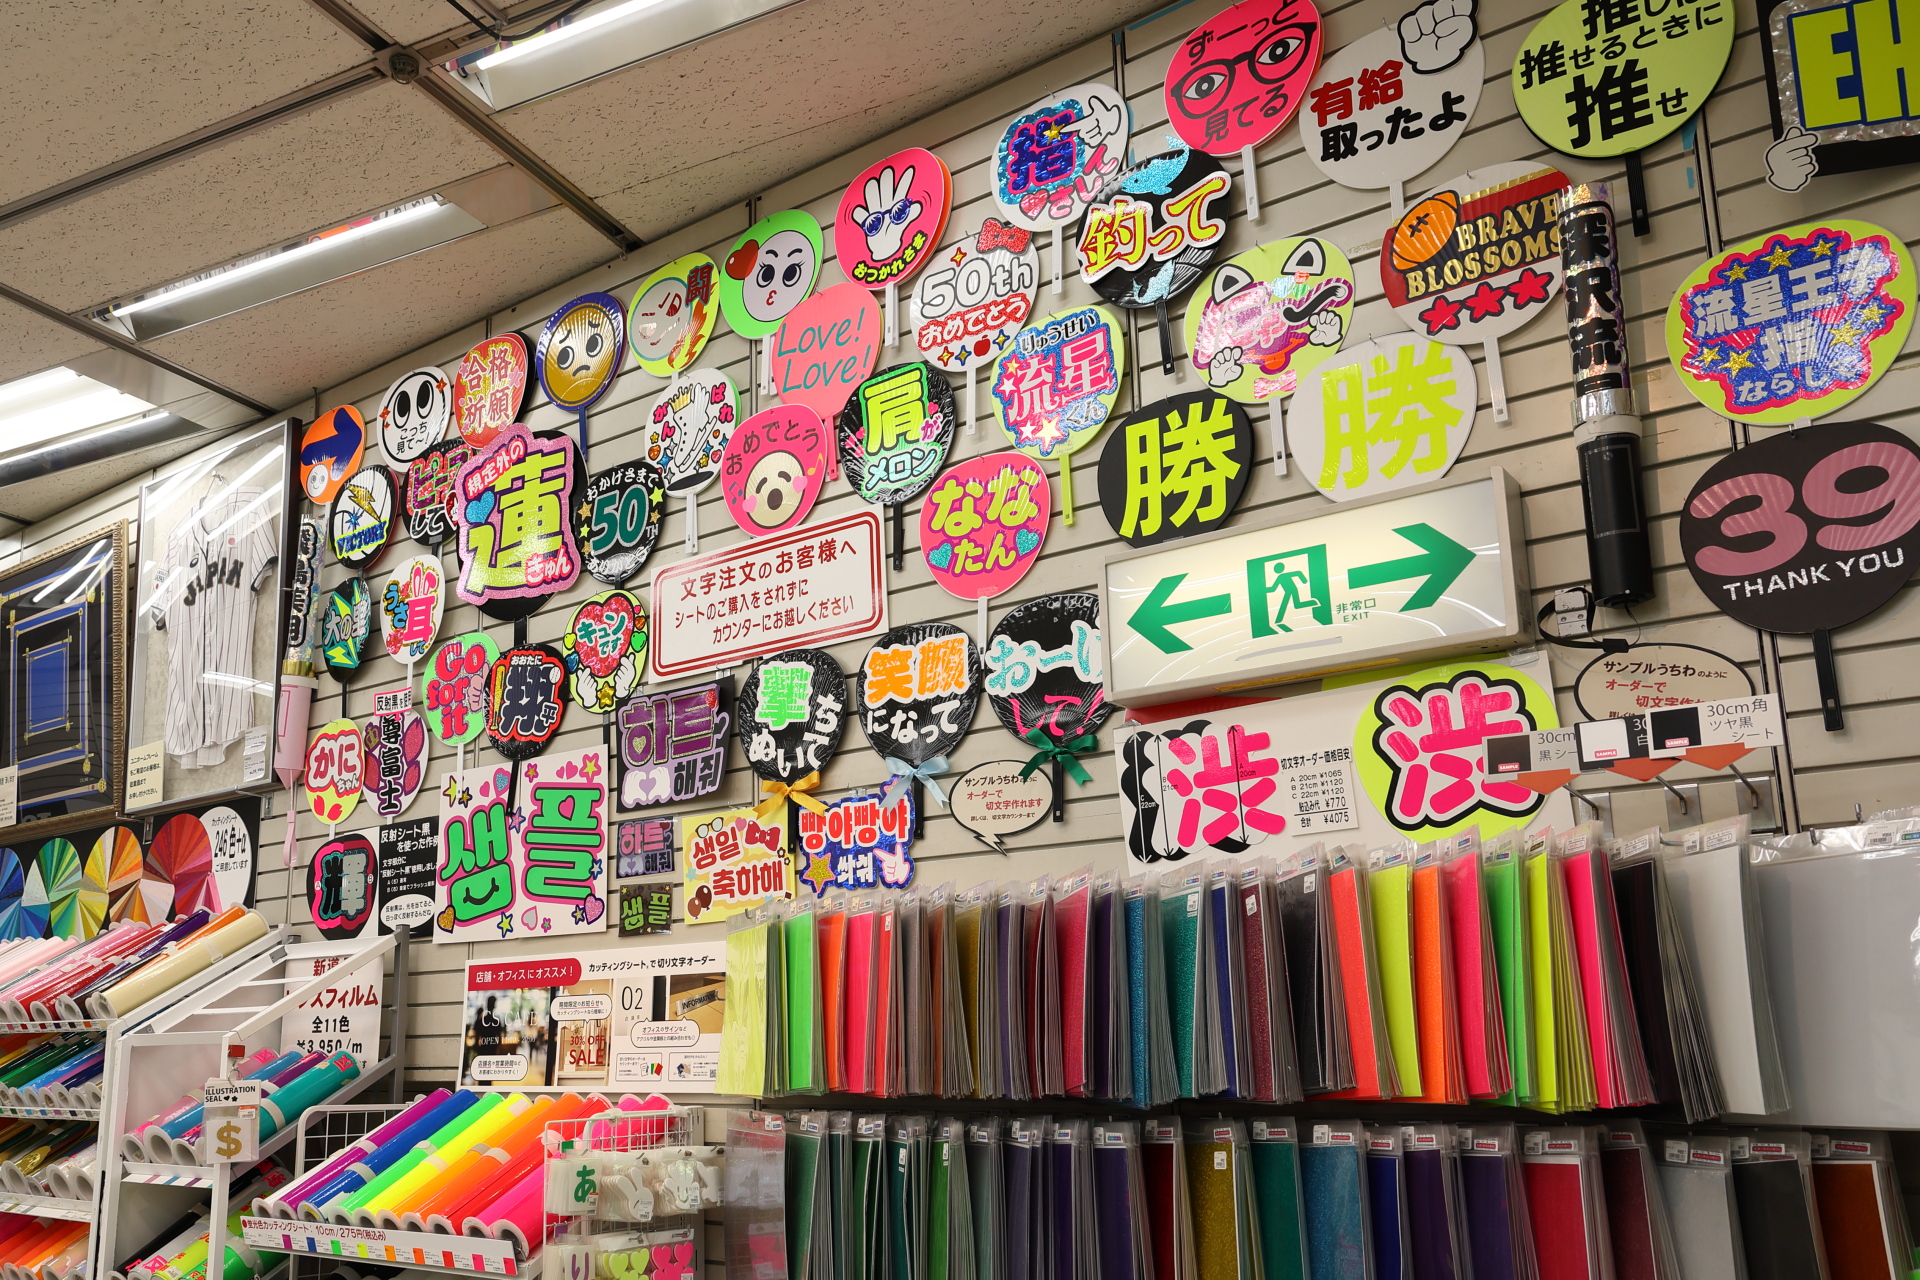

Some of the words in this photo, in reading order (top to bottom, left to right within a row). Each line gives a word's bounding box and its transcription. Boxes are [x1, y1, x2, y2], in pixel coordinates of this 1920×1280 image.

[1580, 0, 1699, 40] 推し
[1519, 2, 1724, 90] 推せるときに
[1309, 60, 1405, 127] 有給
[1564, 58, 1690, 150] 推せ
[1202, 84, 1289, 149] 見てる
[1319, 90, 1468, 163] 取ったよ
[1008, 109, 1077, 195] 指
[1082, 172, 1227, 282] 釣って
[1456, 196, 1562, 251] BRAVE
[854, 232, 928, 283] おつかれさま
[1406, 227, 1565, 300] BLOSSOMS
[685, 265, 715, 307] 闘
[920, 255, 1034, 319] 50th
[1695, 244, 1892, 336] 流星王子
[778, 307, 866, 360] Love!
[918, 294, 1032, 349] おめでとう
[1020, 310, 1098, 353] りゅうせい
[463, 346, 513, 392] 合格
[781, 343, 871, 394] Love!
[1008, 328, 1112, 423] 流星
[463, 389, 512, 430] 祈願
[653, 402, 676, 440] がん
[710, 382, 734, 423] ばれ
[863, 370, 926, 455] 肩
[1064, 398, 1104, 427] くん
[1317, 340, 1465, 492] 勝
[399, 420, 428, 442] こっち
[726, 419, 820, 476] おめでとう
[465, 440, 527, 498] 規定外の
[586, 465, 660, 502] おかげさまで
[867, 447, 939, 488] メロン
[1118, 398, 1242, 540] 勝
[590, 483, 650, 557] 50
[930, 464, 1041, 538] なな
[1689, 441, 1920, 577] 39
[335, 521, 389, 558] VICTORY
[464, 449, 567, 594] 蓮
[646, 523, 660, 539] TH
[525, 546, 573, 584] きゅん
[680, 537, 857, 602] 文字注文のお客様へ
[953, 533, 1017, 574] たん
[1723, 563, 1831, 600] THANK
[1835, 547, 1905, 578] YOU
[385, 583, 410, 629] うさ
[674, 578, 810, 630] シートのご購入をされずに
[711, 595, 855, 646] カウンターにお越しください
[1336, 598, 1377, 614] 非常口
[1343, 611, 1371, 623] EXIT
[576, 610, 628, 643] キュン
[410, 640, 427, 657] して
[434, 642, 486, 681] Go
[510, 655, 543, 666] おおたに
[596, 635, 623, 659] です
[867, 636, 968, 704] 笑顔
[1603, 661, 1729, 682] サンプルうちわのように
[1605, 678, 1668, 694] オーダーで
[427, 677, 470, 711] for
[1706, 697, 1769, 719] 30cm角
[441, 702, 470, 740] it
[541, 701, 560, 727] 平
[623, 697, 718, 767] 하트
[866, 700, 962, 745] になって
[1708, 715, 1755, 732] ツヤ黒
[1594, 749, 1618, 759] SAMPLE
[1666, 737, 1689, 748] SAMPLE
[1731, 728, 1775, 744] シート
[313, 741, 358, 780] かに
[672, 748, 721, 798] 해줘
[1239, 770, 1257, 778] 20cm
[1280, 747, 1351, 771] 切文字オーダー価格目安
[1299, 774, 1318, 782] 20cm
[1319, 770, 1343, 778] ¥1065
[1498, 763, 1520, 772] SAMPLE
[336, 772, 361, 794] ちゃん
[966, 789, 1004, 801] オーダーで
[1162, 784, 1179, 792] 21cm
[1167, 724, 1288, 847] 渋
[1300, 790, 1320, 799] 22cm
[1321, 787, 1345, 795] ¥1120
[1320, 778, 1344, 787] ¥1120
[985, 798, 1044, 811] 切文字作れます
[1140, 801, 1157, 809] 22cm
[1300, 816, 1312, 828] 合計
[1323, 811, 1350, 825] ¥4075
[1324, 796, 1347, 809] ¥770
[380, 822, 431, 845] 反射シート黒
[691, 824, 740, 870] 생일
[437, 786, 602, 923] 샘플
[711, 861, 785, 902] 축하해
[621, 986, 644, 1011] 02
[681, 990, 716, 1011] INFORMATION
[311, 1015, 350, 1034] 全11色
[481, 1011, 501, 1028] CS
[568, 1048, 606, 1067] SALE
[569, 1035, 586, 1046] 30%
[587, 1034, 606, 1046] OFF
[205, 1085, 256, 1096] ILLUSTRATION
[205, 1095, 223, 1103] SEAL
[215, 1120, 243, 1160] $
[573, 1164, 597, 1203] あ
